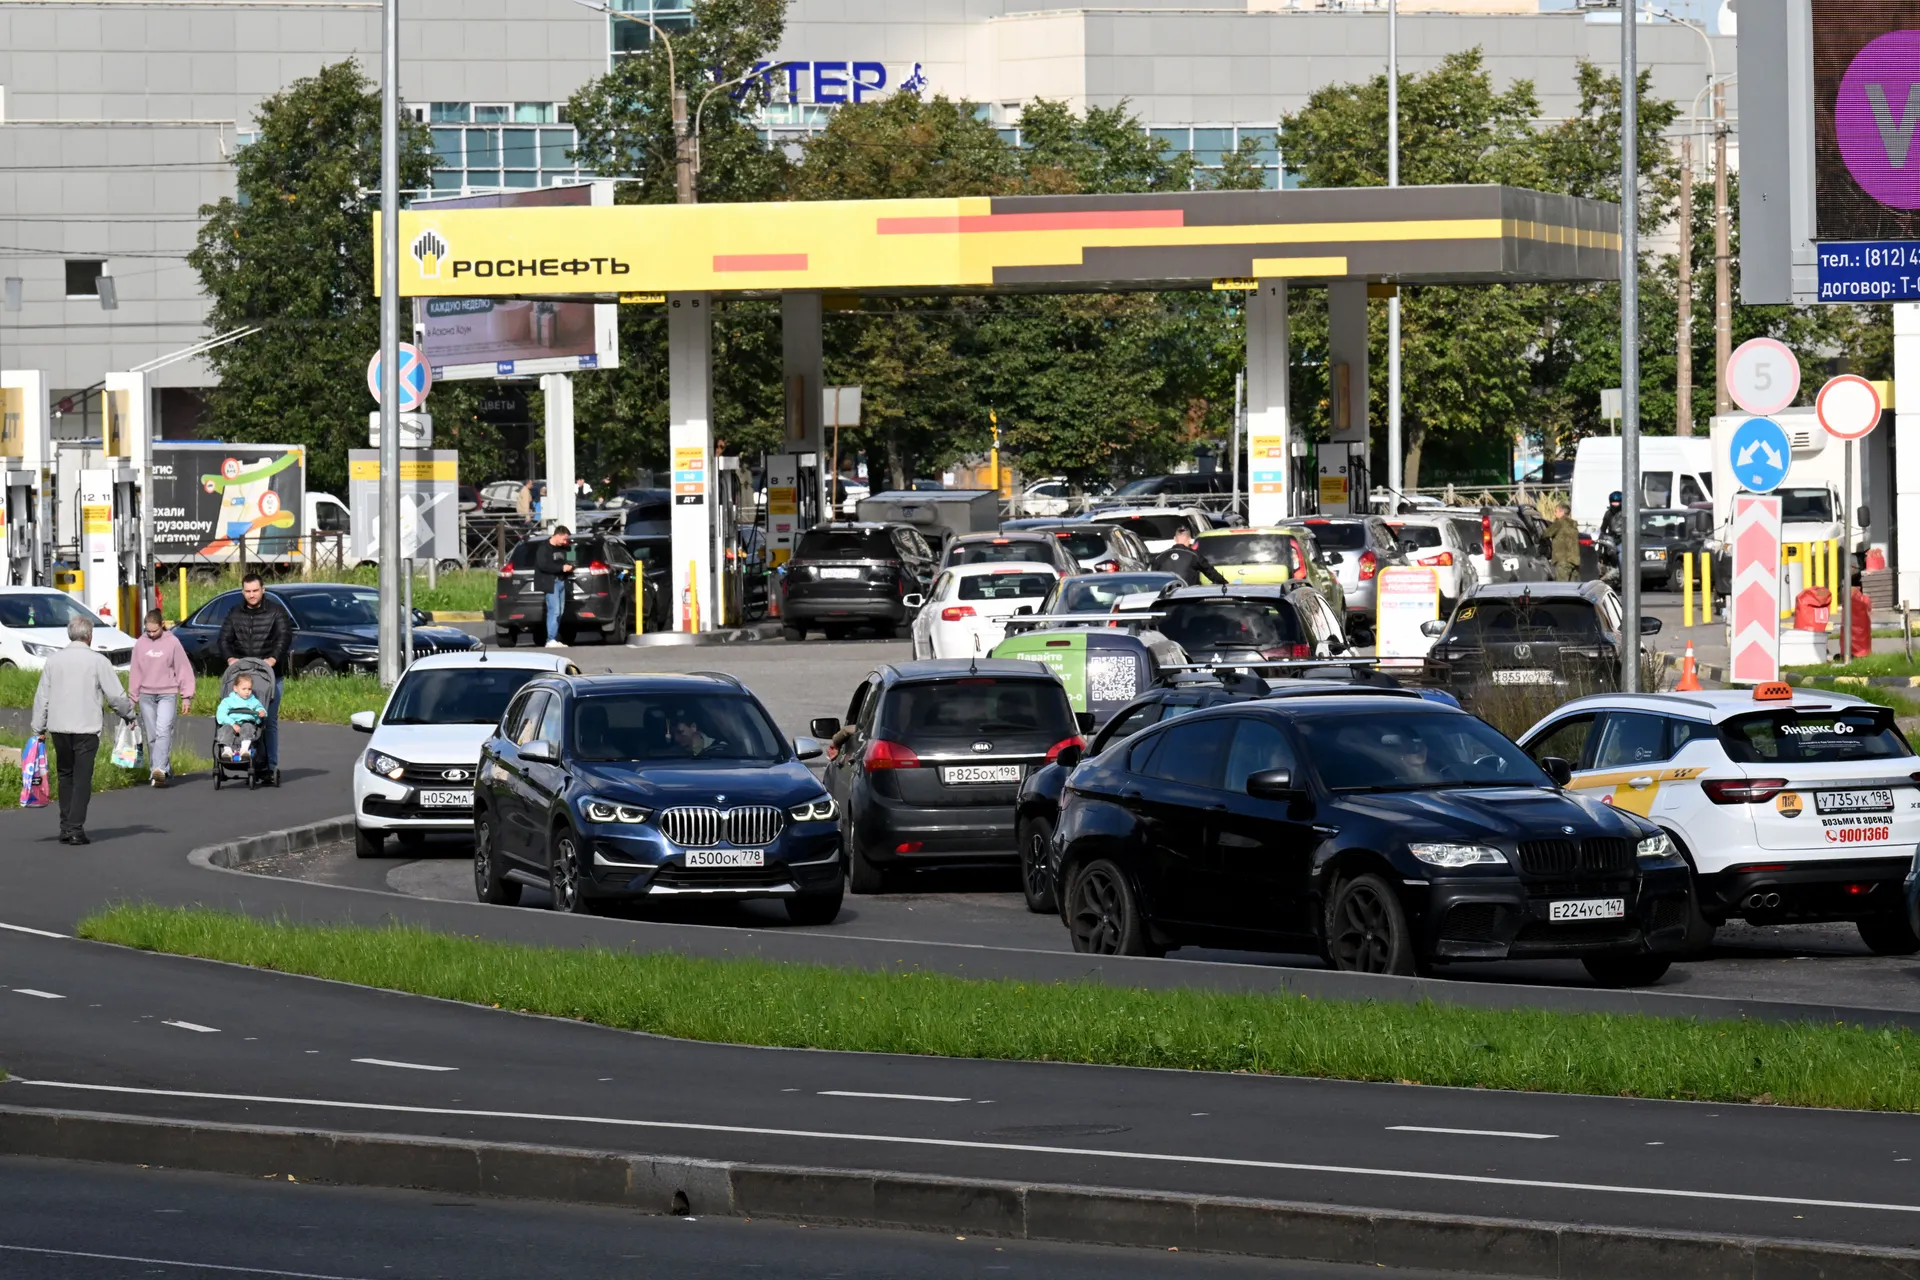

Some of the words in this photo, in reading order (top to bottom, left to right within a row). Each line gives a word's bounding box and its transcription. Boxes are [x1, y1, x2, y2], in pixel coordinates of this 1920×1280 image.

[1820, 254, 1860, 267] тел.:
[1865, 247, 1905, 268] (812)
[453, 257, 630, 278] РОСНЕФТЬ
[1271, 287, 1277, 296] 1
[1821, 281, 1896, 298] договор:
[430, 300, 461, 313] КАЖДУЮ
[461, 298, 490, 310] НЕДЕЛЮ
[672, 300, 681, 308] 6
[692, 299, 700, 308] 5
[1754, 362, 1772, 391] 5
[480, 400, 515, 411] ЦВЕТЫ
[771, 477, 779, 485] 8
[787, 477, 795, 485] 7
[83, 493, 95, 502] 12
[683, 496, 697, 504] ДТ
[1781, 724, 1834, 735] Яндекс
[1833, 722, 1854, 735] Go
[999, 767, 1017, 776] 198
[1870, 791, 1889, 802] 198
[1822, 818, 1855, 827] возьми
[1863, 815, 1893, 825] аренду
[1839, 826, 1889, 843] 9001366
[742, 850, 760, 861] 778
[1605, 900, 1622, 912] 147
